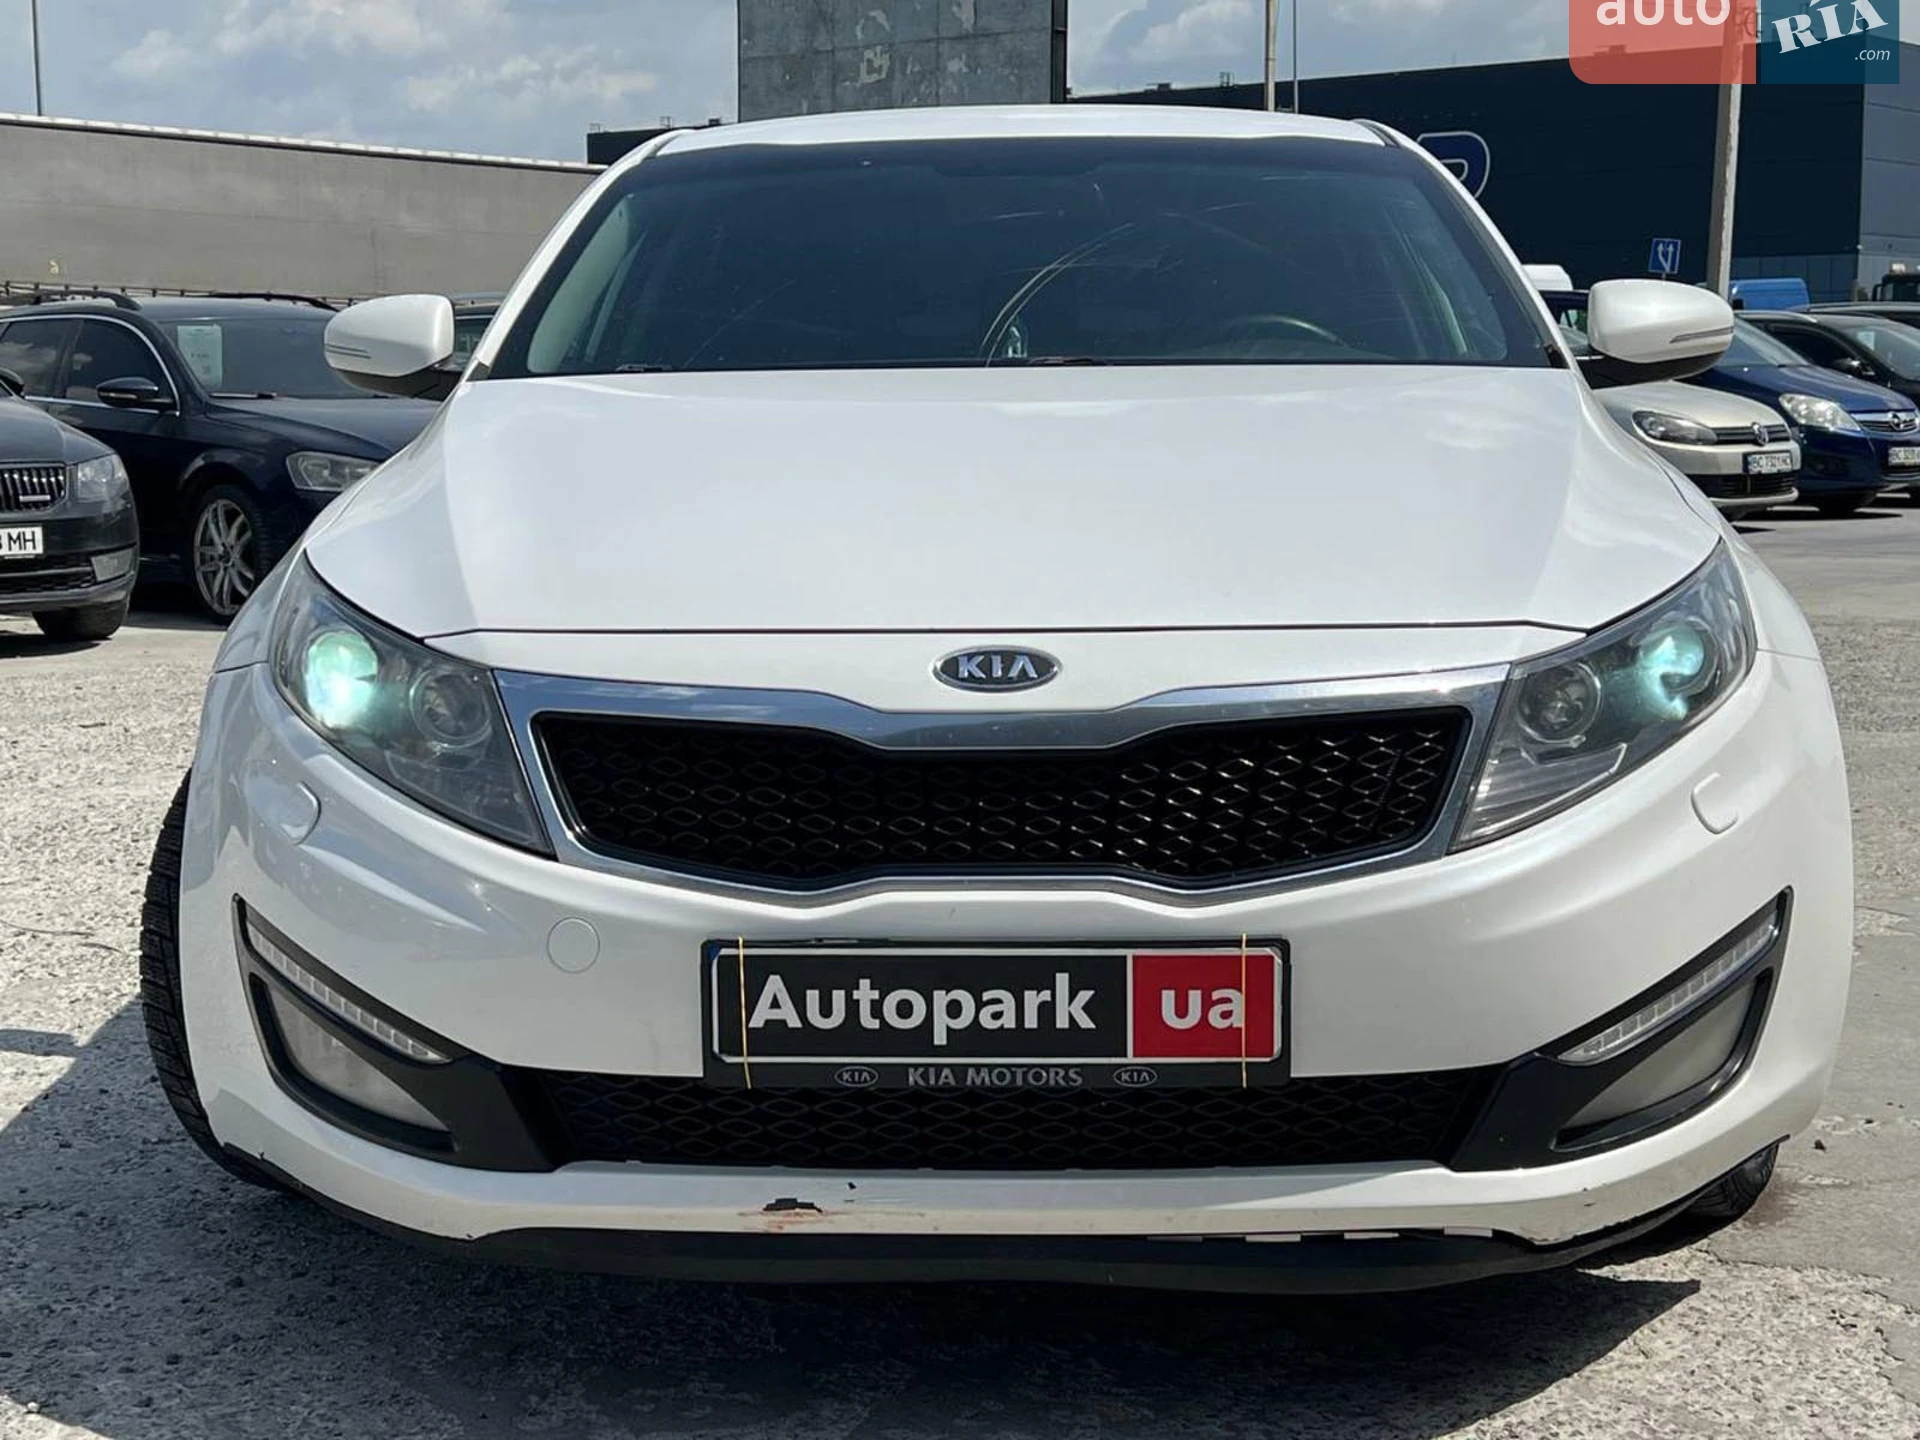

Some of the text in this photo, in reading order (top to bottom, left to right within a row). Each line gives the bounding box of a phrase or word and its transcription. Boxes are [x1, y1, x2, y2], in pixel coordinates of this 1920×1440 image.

[7, 530, 37, 552] MH
[957, 654, 1038, 679] KIA
[748, 972, 1245, 1046] Autopark ua
[841, 1071, 870, 1083] KIA
[907, 1066, 1084, 1087] KIA MOTORS
[1121, 1071, 1150, 1083] KIA
